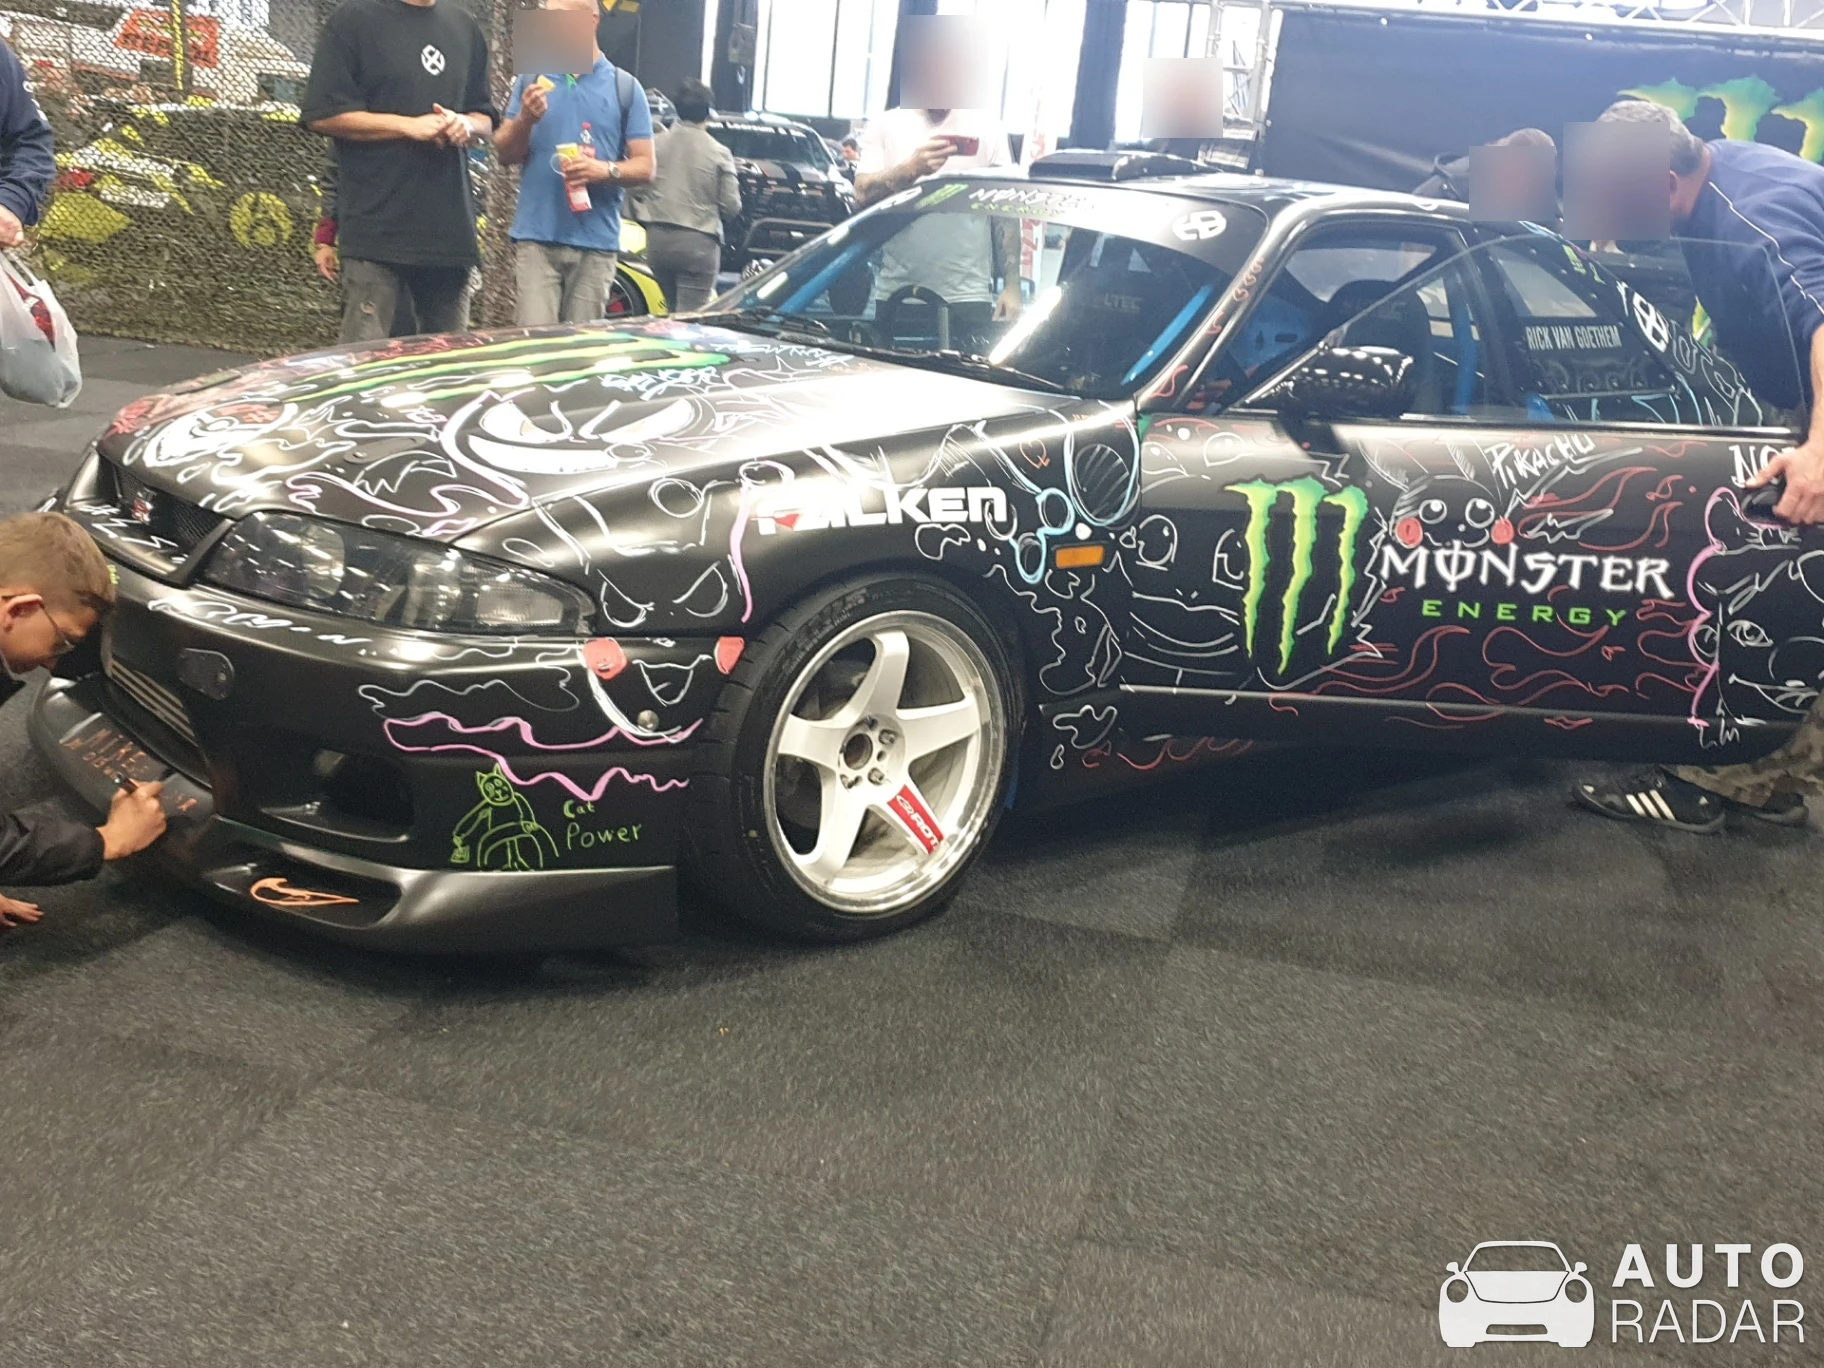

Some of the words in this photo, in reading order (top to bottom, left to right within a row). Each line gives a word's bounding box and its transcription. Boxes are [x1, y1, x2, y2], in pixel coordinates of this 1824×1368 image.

[969, 187, 1095, 211] MONST
[1525, 326, 1553, 350] RICK
[1551, 326, 1575, 349] VAN
[1484, 433, 1596, 490] PIKACHU
[751, 486, 1007, 536] FALKEN
[1380, 540, 1675, 600] MONSTER
[1422, 600, 1626, 626] ENERGY
[563, 800, 595, 818] Cat
[567, 822, 641, 850] Power
